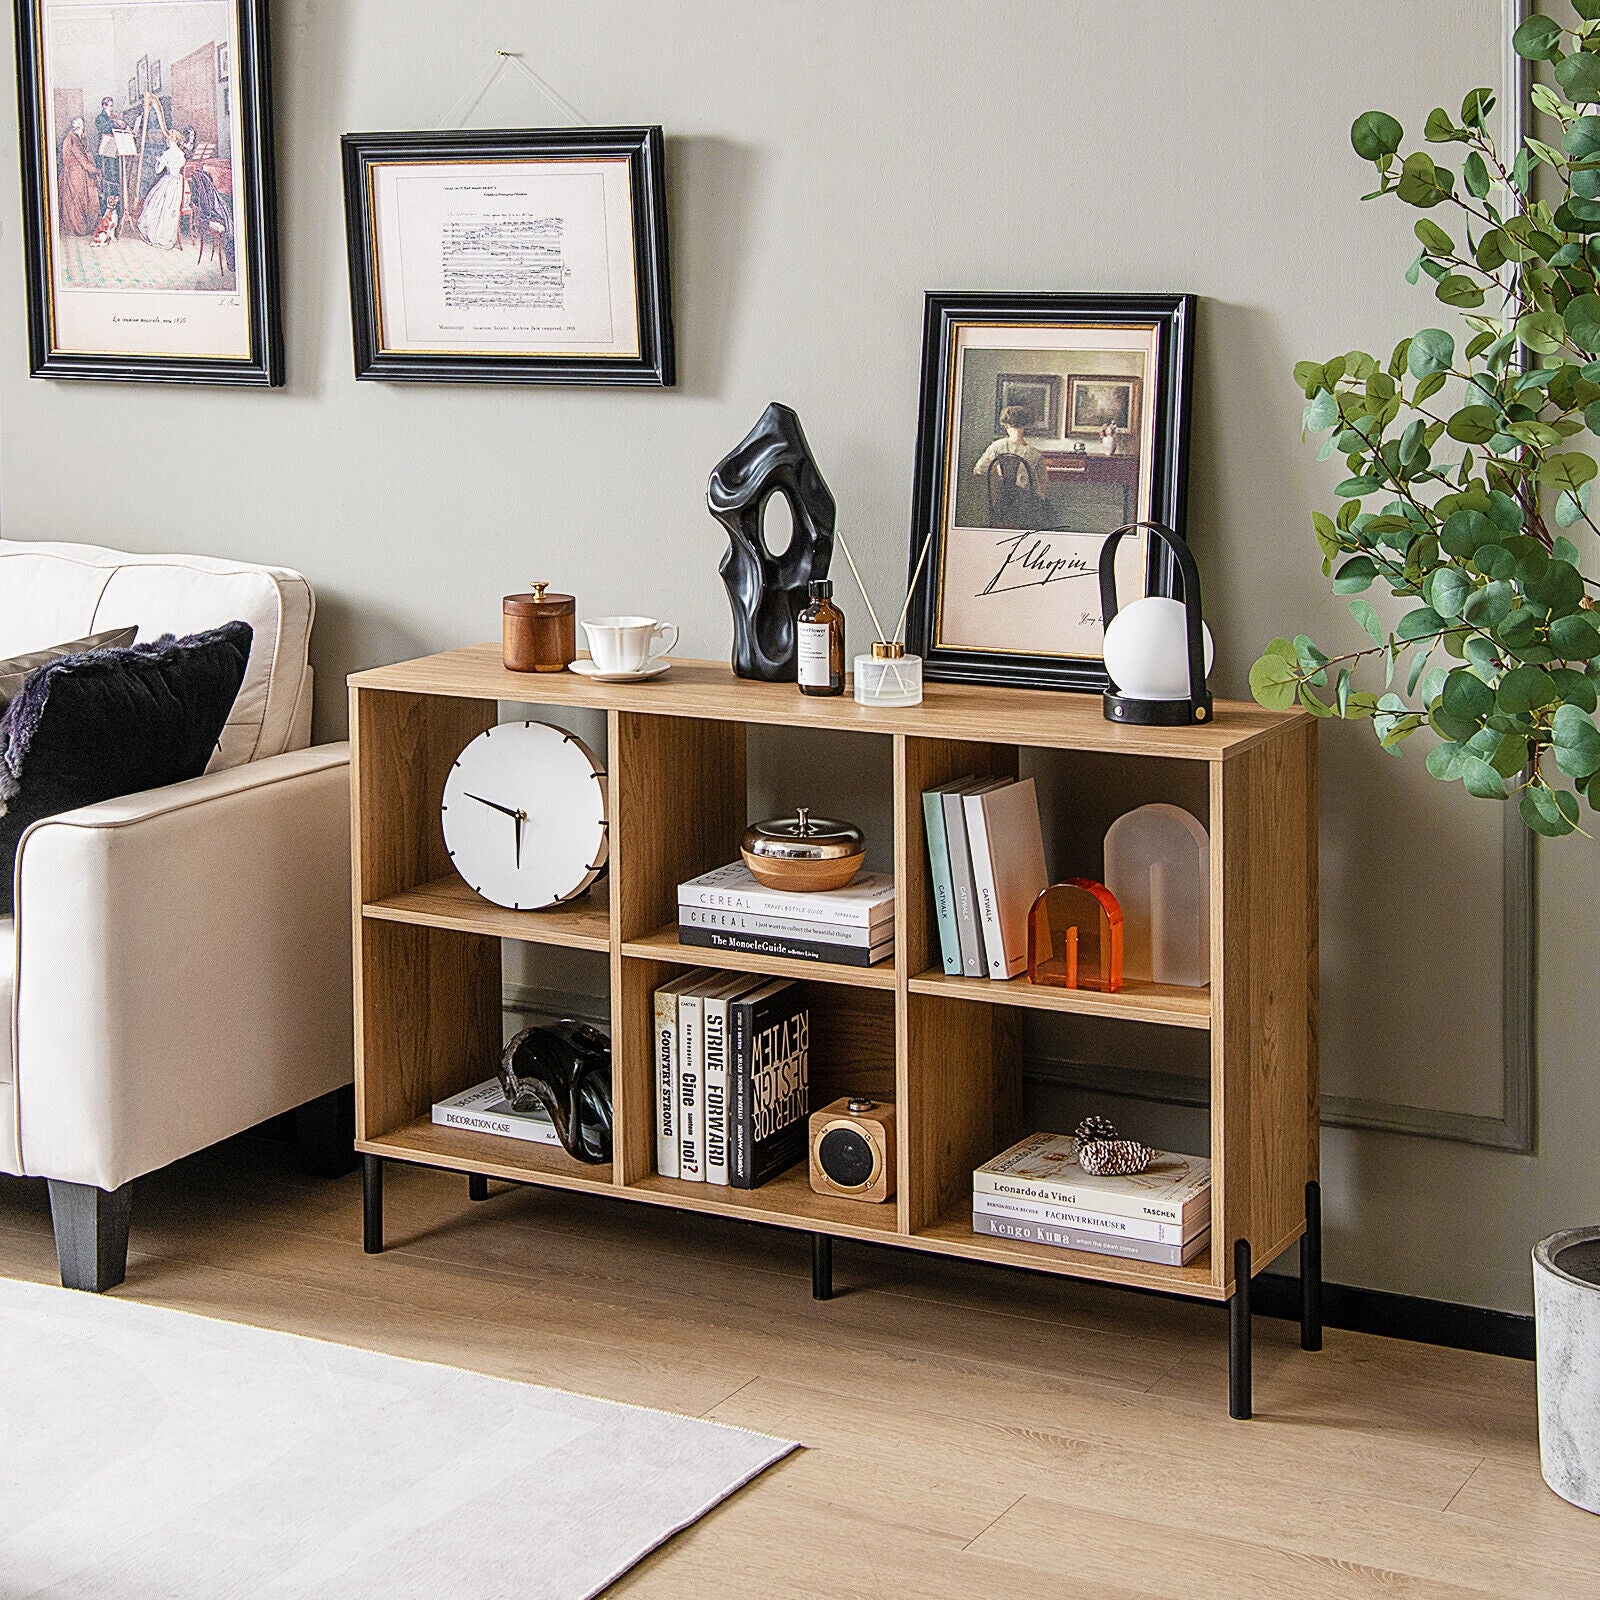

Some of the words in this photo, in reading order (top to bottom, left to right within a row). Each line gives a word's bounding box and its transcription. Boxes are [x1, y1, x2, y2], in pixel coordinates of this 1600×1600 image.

[699, 893, 751, 909] CEREAL
[938, 884, 948, 919] CATWALK
[959, 886, 969, 921] CATWALK
[982, 888, 993, 923] CATWALK
[691, 911, 746, 928] CEREAL
[787, 925, 803, 933] collect
[813, 928, 834, 936] beautiful
[835, 931, 852, 939] things
[711, 934, 727, 945] The
[661, 1029, 672, 1088] COUNTRY
[707, 1014, 724, 1072] STRIVE
[751, 1009, 809, 1080] REVIEW
[682, 1072, 697, 1107] Cine
[753, 1051, 809, 1116] DESIGN
[446, 1113, 491, 1129] DECORATION
[491, 1122, 511, 1133] CASE
[662, 1088, 673, 1137] STRONG
[708, 1084, 724, 1167] FORWARD
[751, 1086, 809, 1142] INTERIOR
[682, 1140, 699, 1174] noi?
[994, 1182, 1037, 1197] Leonardo
[1038, 1189, 1049, 1199] da
[1051, 1191, 1076, 1203] Vinci
[1143, 1207, 1176, 1219] TASCHEN
[988, 1219, 1031, 1237] Kengo
[1037, 1227, 1070, 1245] Kuma
